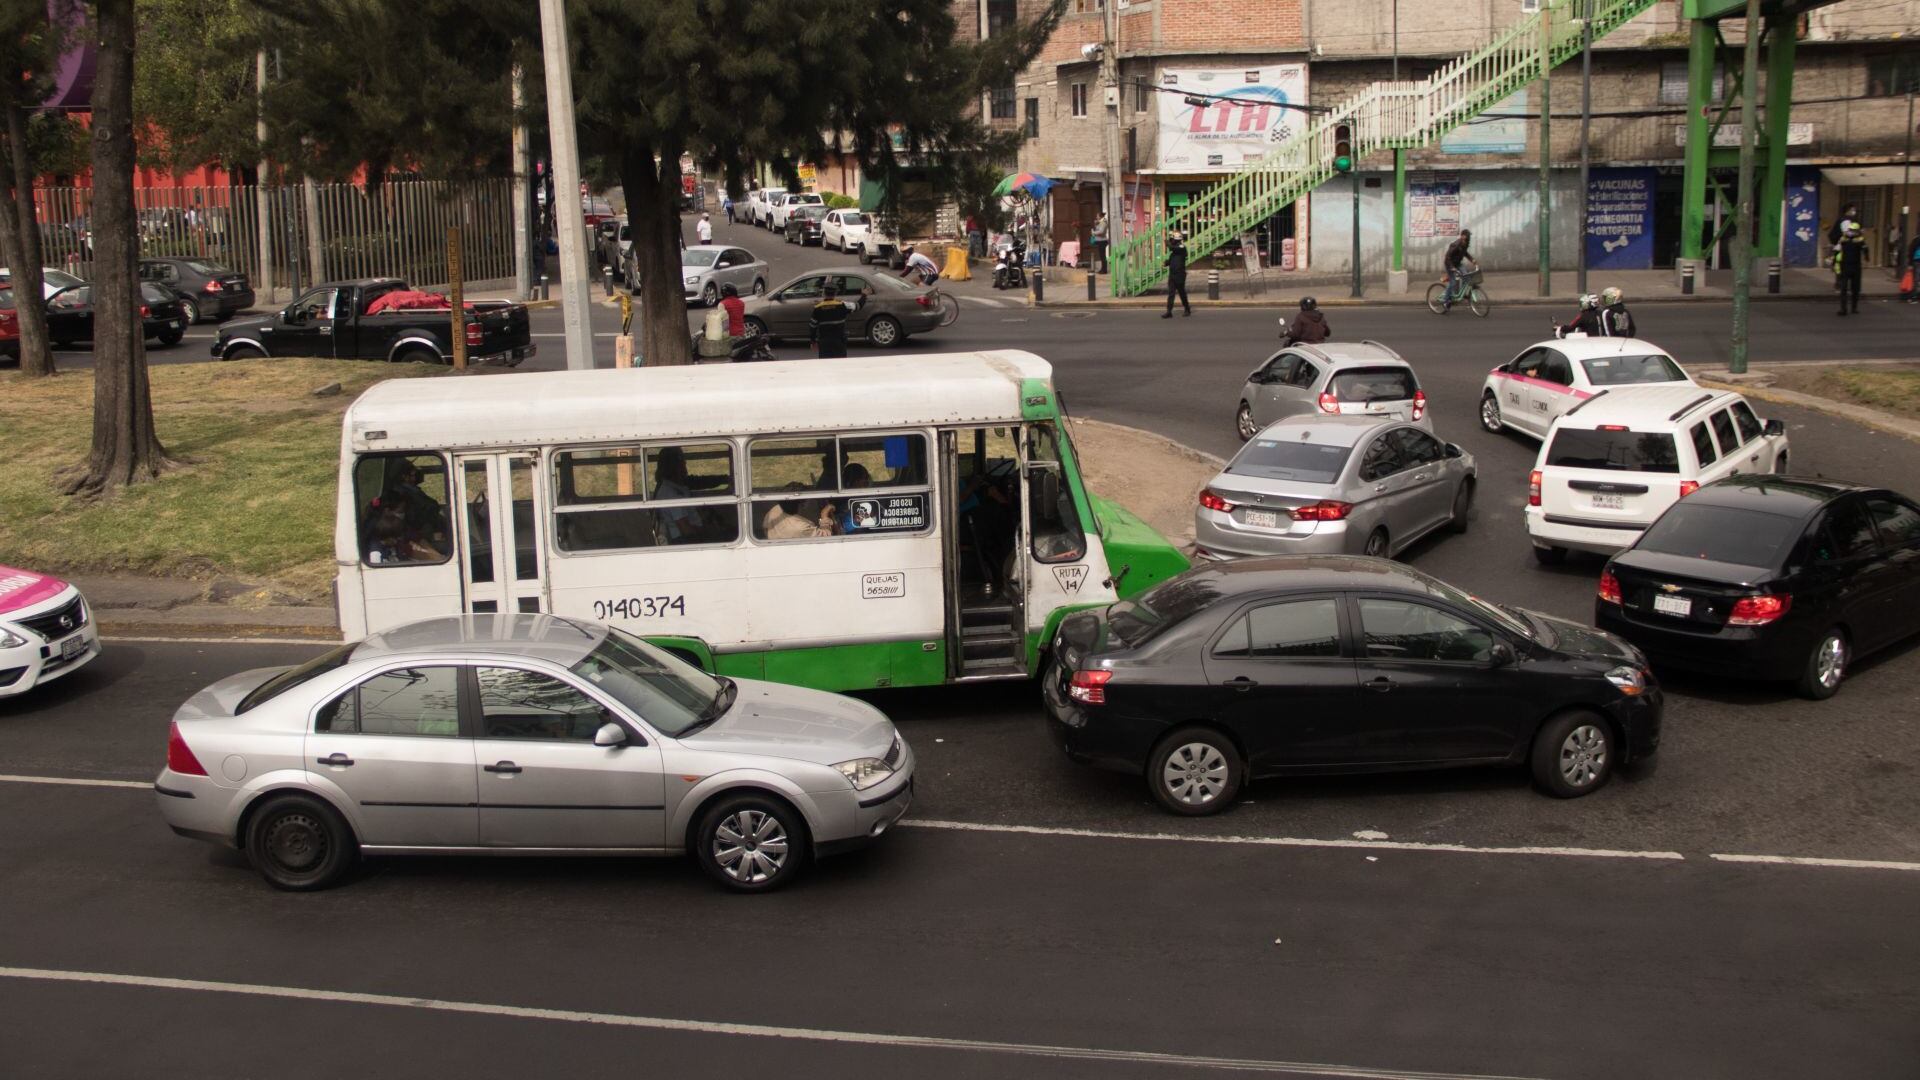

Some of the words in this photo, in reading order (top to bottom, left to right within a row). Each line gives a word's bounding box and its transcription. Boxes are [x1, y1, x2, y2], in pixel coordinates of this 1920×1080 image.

[1189, 101, 1270, 133] LTH
[1597, 179, 1645, 190] VACUNAS
[1594, 213, 1644, 224] HOMEOPATIA
[1595, 225, 1642, 236] ORTOPEDIA
[1509, 392, 1520, 406] TAXI
[1532, 399, 1548, 411] CDMX
[1059, 568, 1082, 578] RUTA
[866, 575, 899, 584] QUEJAS
[1066, 580, 1077, 590] 14
[593, 595, 685, 620] 0140374
